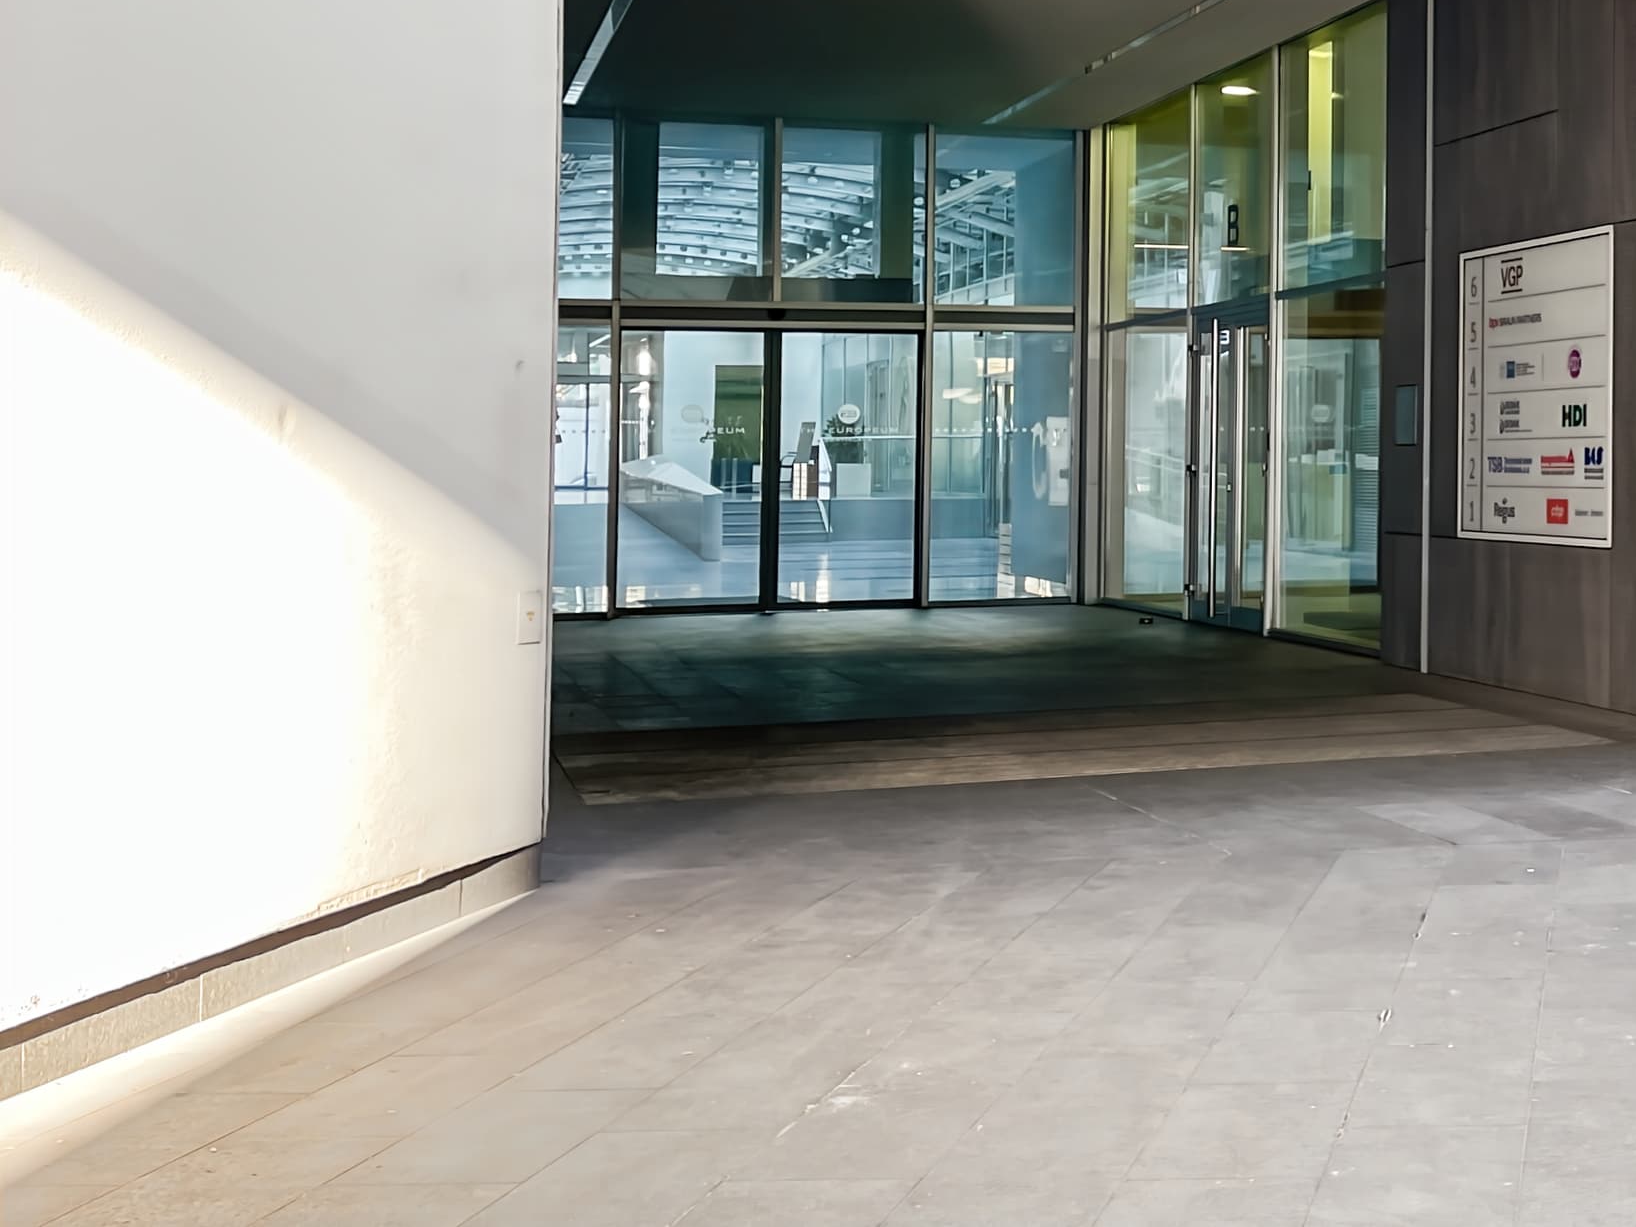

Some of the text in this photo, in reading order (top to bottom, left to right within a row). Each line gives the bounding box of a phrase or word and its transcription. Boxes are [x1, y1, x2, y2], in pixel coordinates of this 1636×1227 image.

[1470, 264, 1524, 298] 6 VGP
[1470, 321, 1477, 343] 5
[1470, 366, 1476, 389] 4
[1469, 412, 1476, 435] 3
[1561, 403, 1588, 428] HDI
[1469, 457, 1476, 480] 2
[1469, 500, 1475, 522] 1
